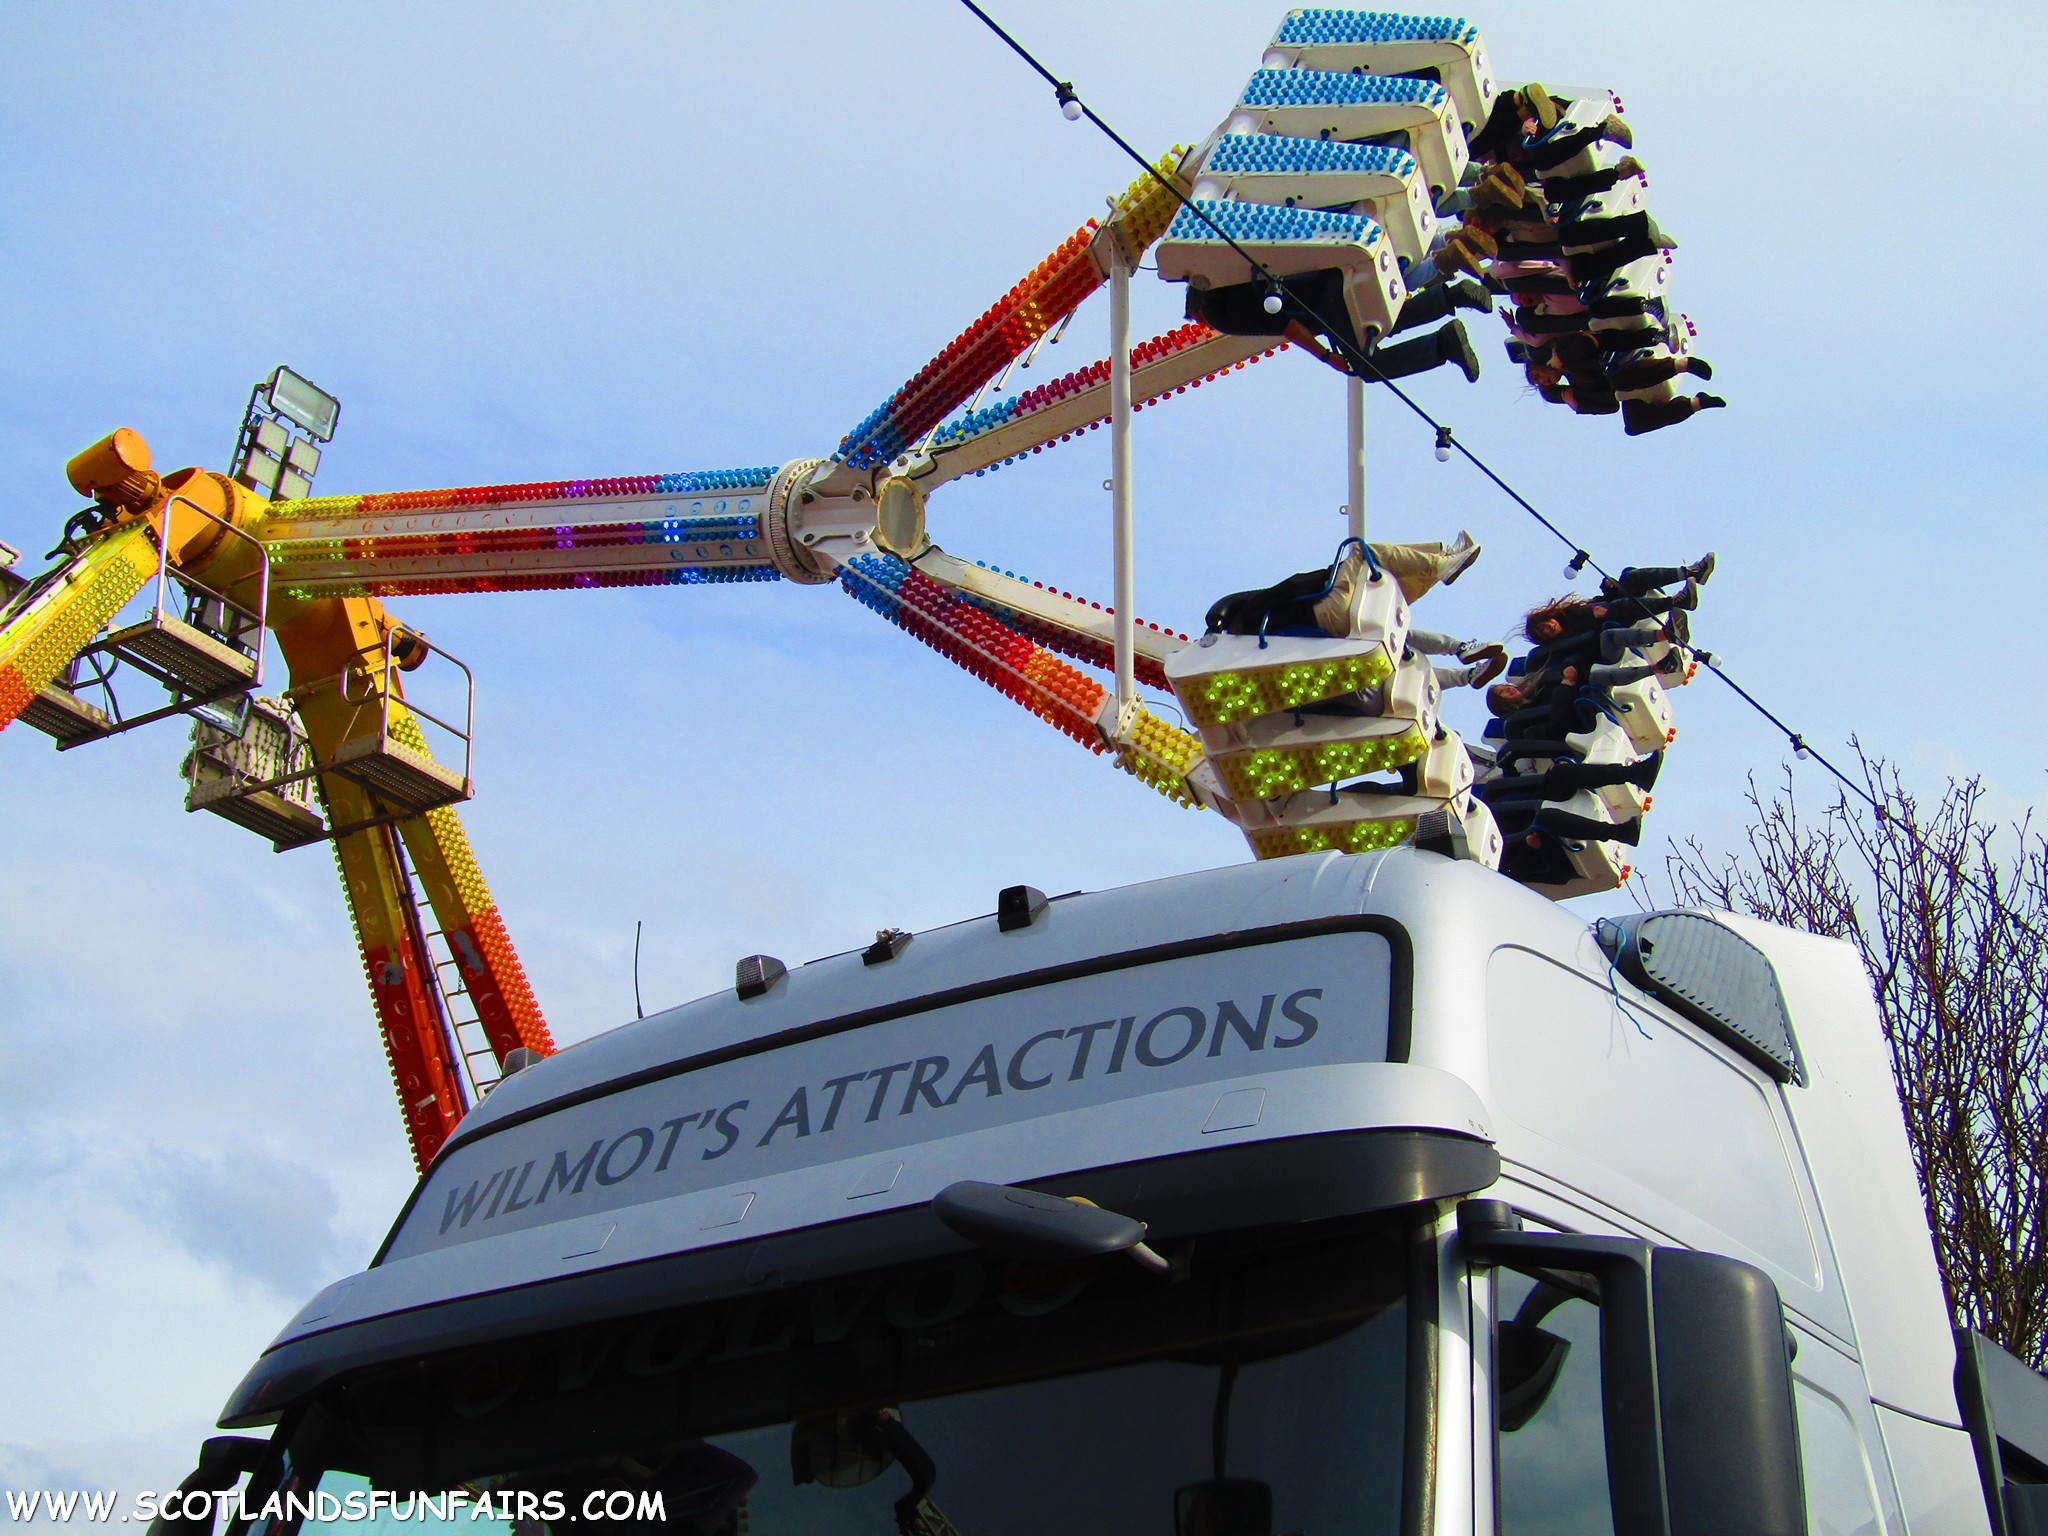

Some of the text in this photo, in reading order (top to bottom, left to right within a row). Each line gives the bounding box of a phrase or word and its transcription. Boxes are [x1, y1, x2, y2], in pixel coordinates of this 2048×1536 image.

[438, 988, 1324, 1236] WILMOT'S ATTRACTIONS
[546, 1260, 987, 1392] VOLVO
